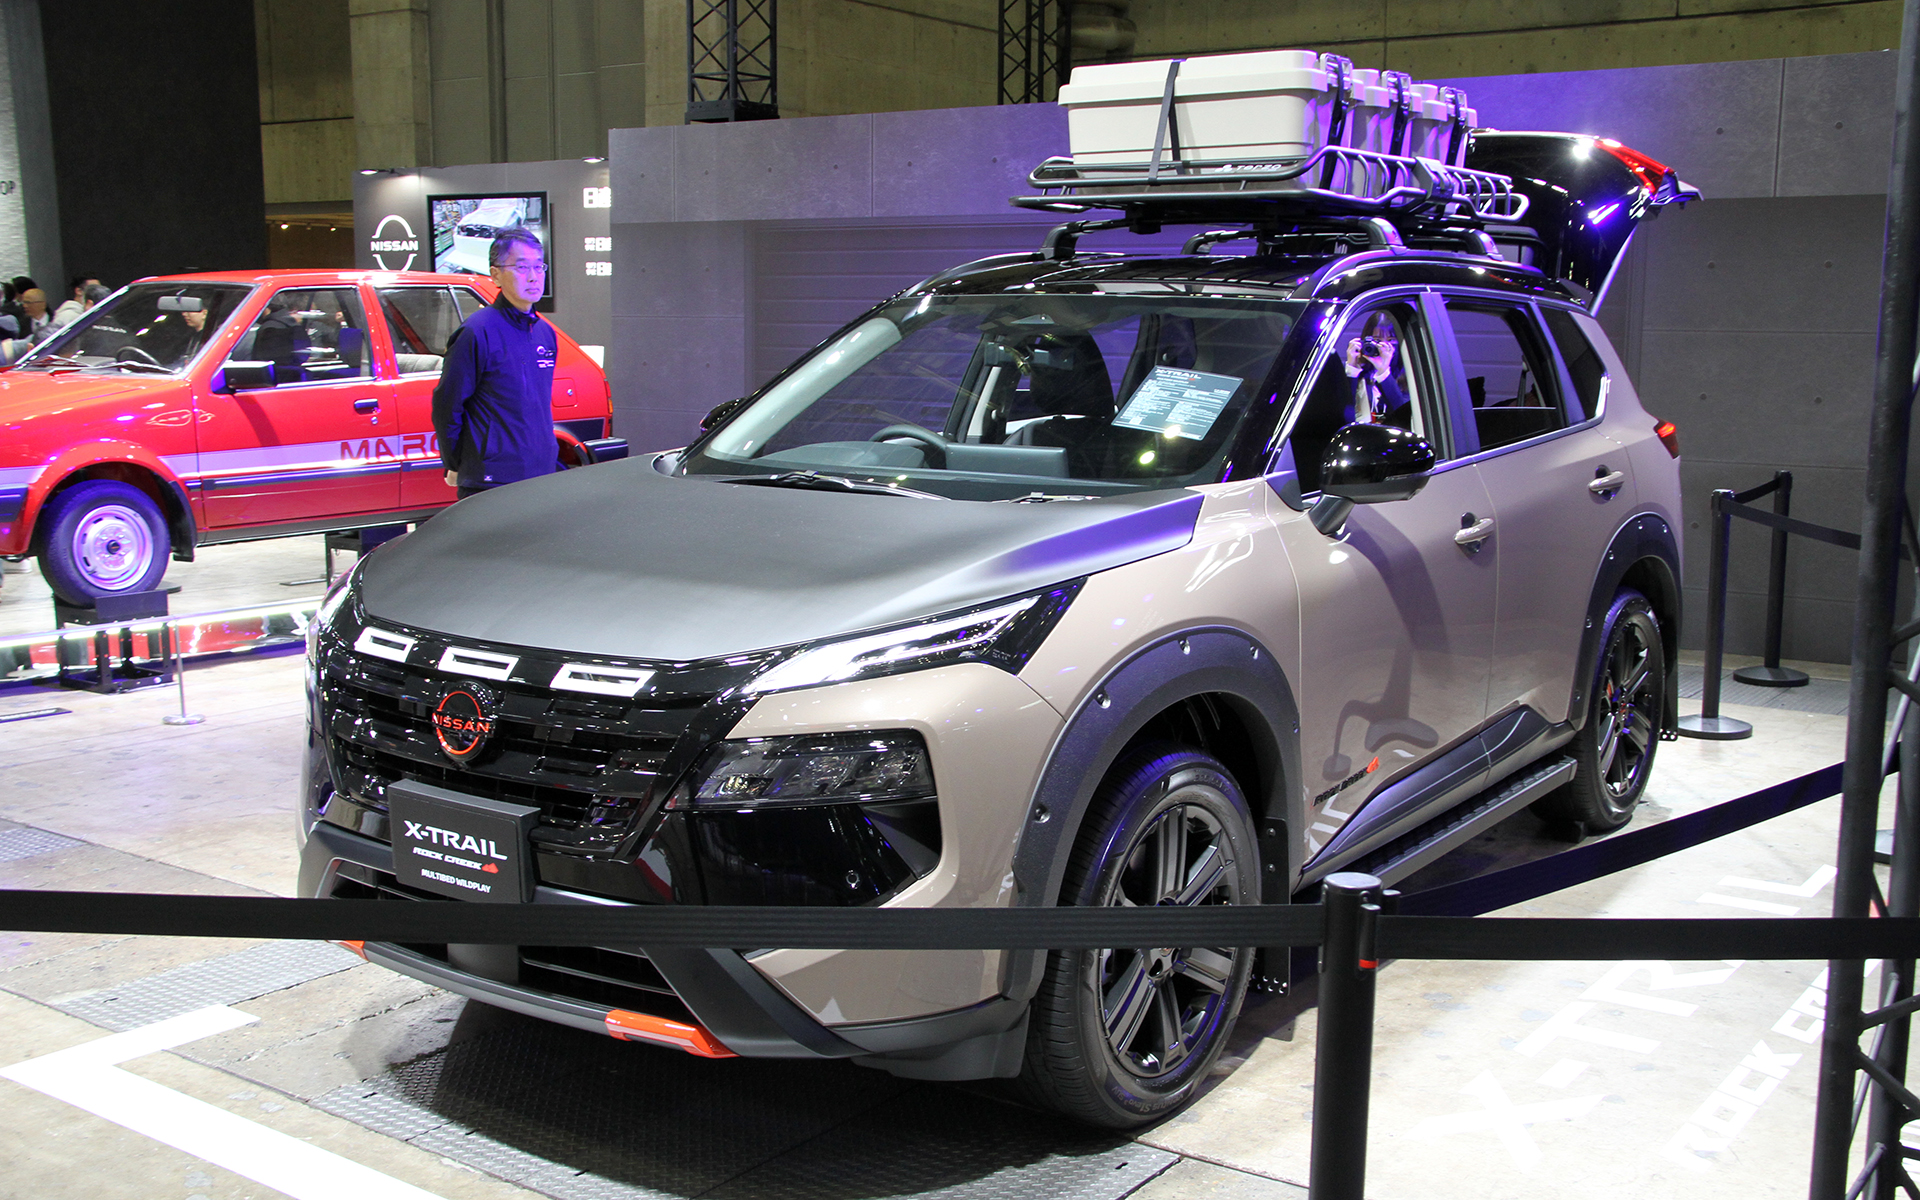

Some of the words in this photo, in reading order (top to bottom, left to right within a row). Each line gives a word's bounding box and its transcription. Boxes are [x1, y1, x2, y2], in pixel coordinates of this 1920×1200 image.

[370, 240, 419, 252] NISSAN
[431, 712, 490, 733] NISSAN
[403, 820, 508, 861] X-TRAIL
[412, 846, 444, 861] ROCK
[421, 868, 456, 885] MULTIBED
[455, 877, 492, 893] WILDPLAY
[1400, 863, 1838, 1174] X-TRIL
[1658, 1039, 1804, 1174] ROCK
